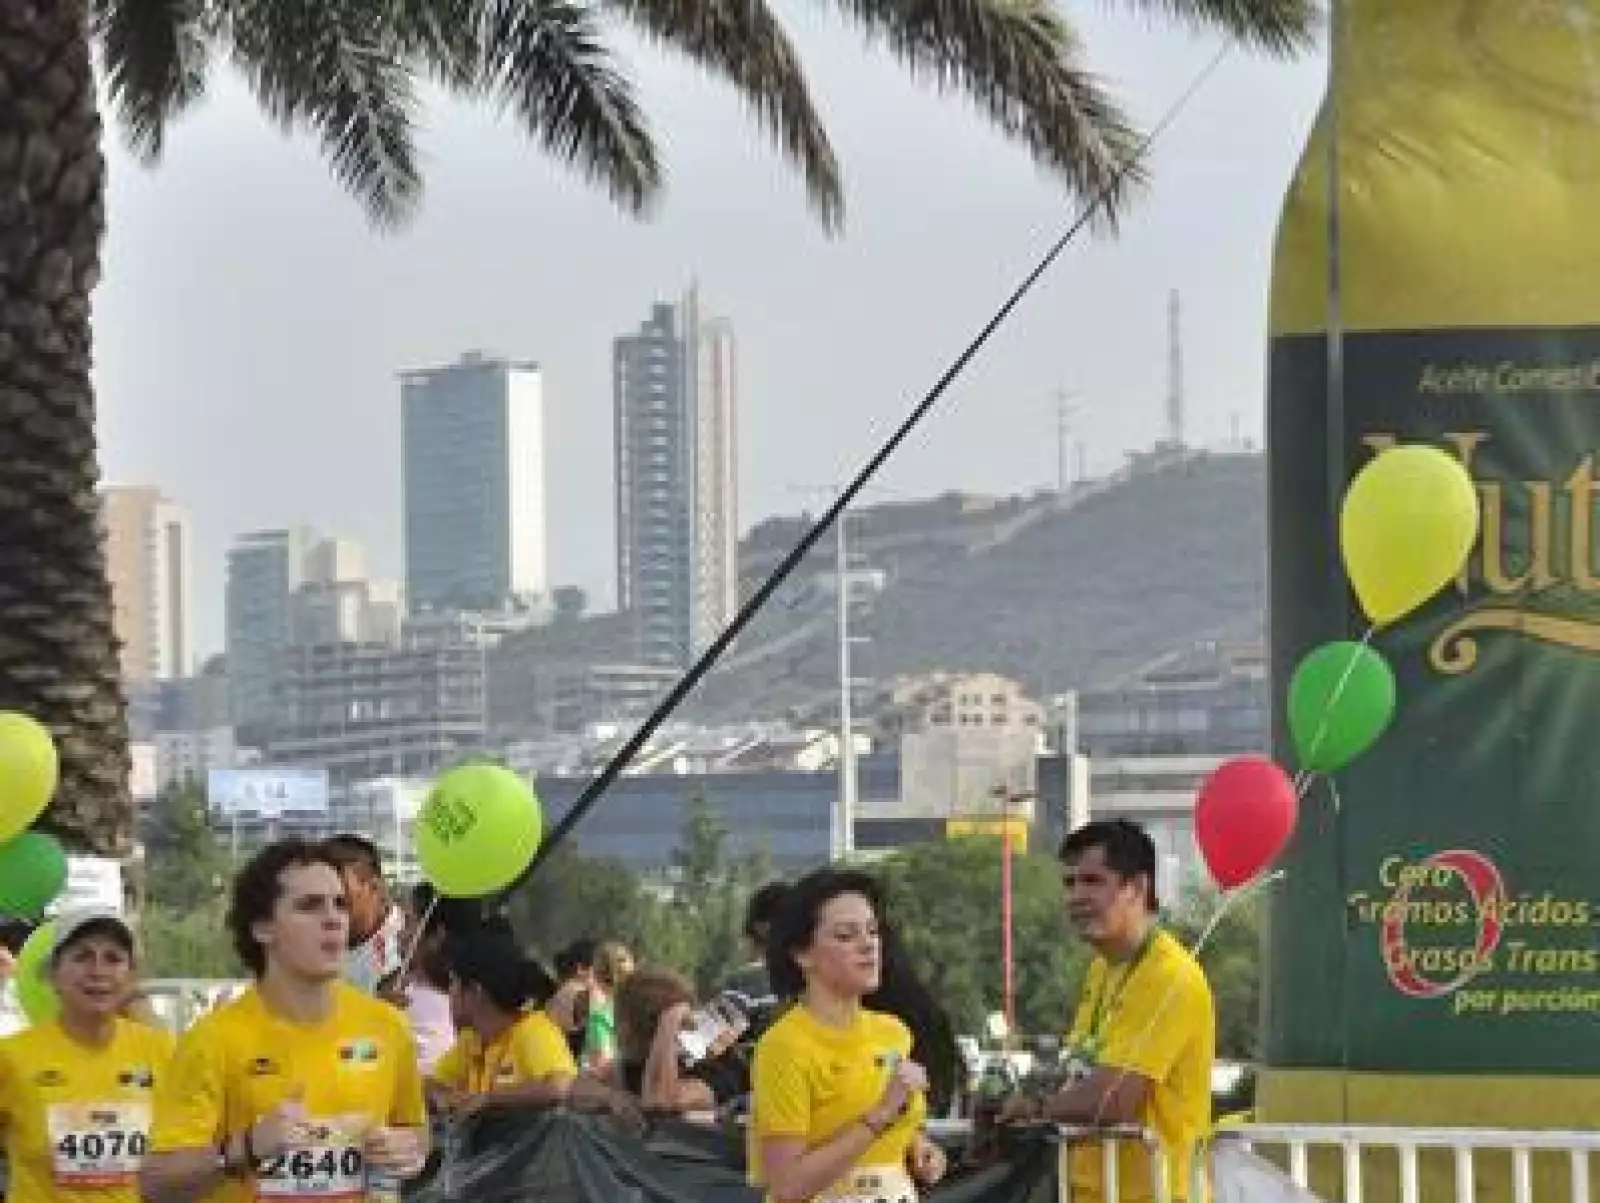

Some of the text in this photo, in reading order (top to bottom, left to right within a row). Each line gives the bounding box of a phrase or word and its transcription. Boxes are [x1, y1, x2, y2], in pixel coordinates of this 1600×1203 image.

[1362, 432, 1600, 595] ut
[58, 1130, 146, 1160] 4070
[260, 1146, 362, 1180] 2640
